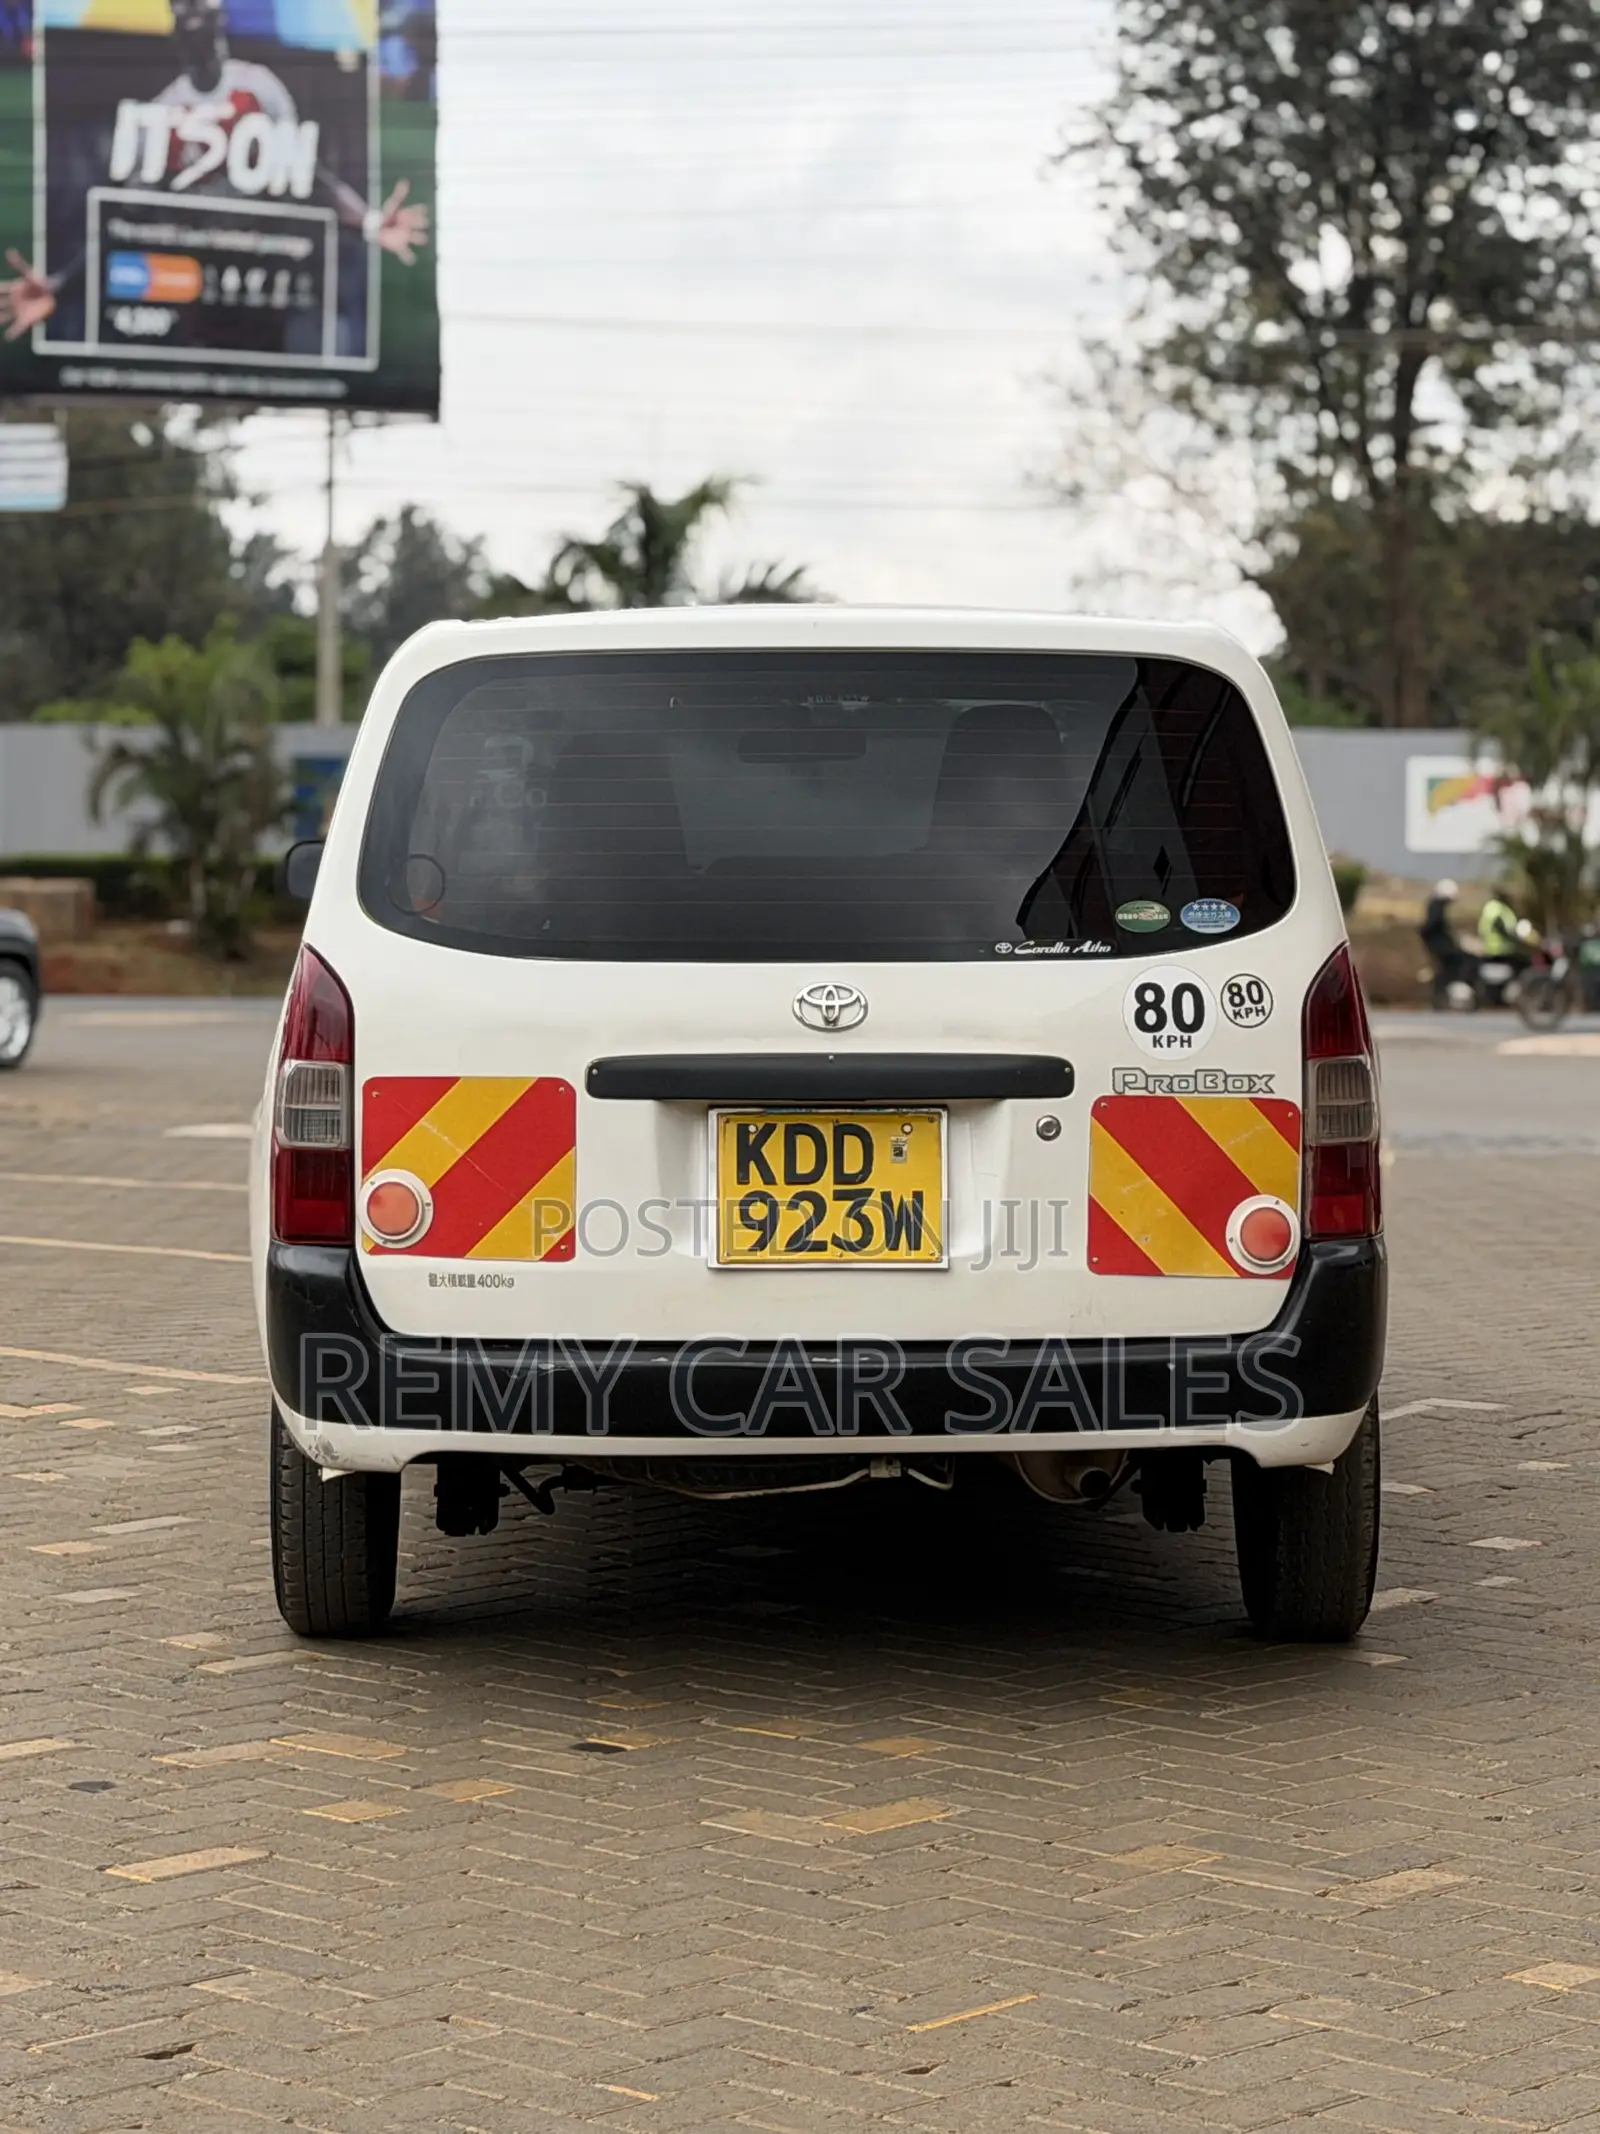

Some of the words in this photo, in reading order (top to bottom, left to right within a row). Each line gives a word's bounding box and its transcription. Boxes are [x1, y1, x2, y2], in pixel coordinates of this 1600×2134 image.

[1014, 940, 1070, 954] Corolla
[1134, 982, 1205, 1033] 80
[1227, 980, 1264, 1008] 80
[1232, 1005, 1266, 1020] KPH
[1152, 1034, 1192, 1048] KPH
[736, 1122, 874, 1186] KDD
[739, 1188, 924, 1252] 923W
